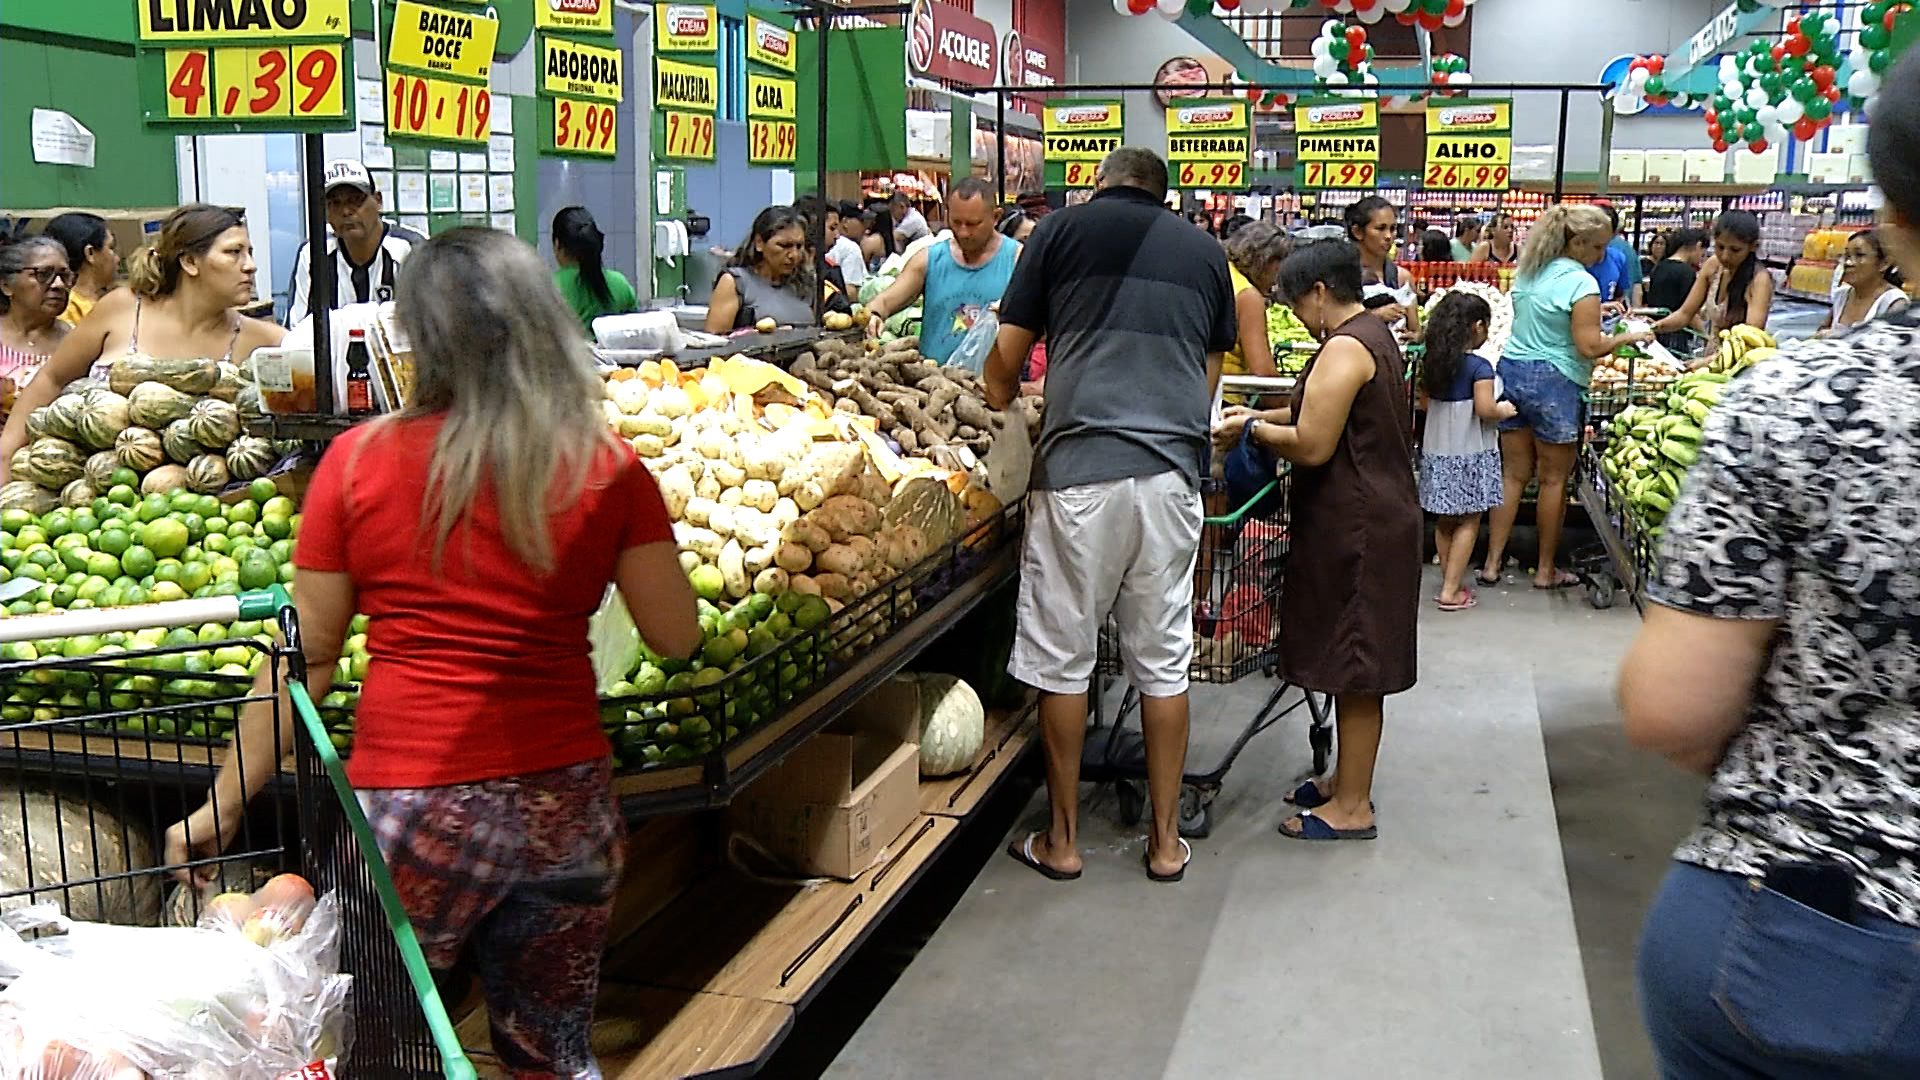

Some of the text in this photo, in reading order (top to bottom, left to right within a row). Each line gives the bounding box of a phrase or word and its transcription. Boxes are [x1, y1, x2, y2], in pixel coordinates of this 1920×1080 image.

[418, 11, 472, 40] BATATA
[422, 35, 462, 59] DOCE
[938, 27, 991, 69] AÇOUGUE
[168, 49, 337, 115] 4,39
[660, 72, 710, 104] MACAXEIRA
[755, 84, 783, 109] CARA
[556, 101, 614, 149] 3,99
[668, 114, 713, 156] 7,79
[752, 123, 795, 159] 13,99
[1170, 139, 1244, 152] BETERRABA
[1300, 139, 1376, 152] PIMENTA
[1435, 143, 1496, 158] ALHO
[1181, 162, 1241, 185] 6,99
[1307, 164, 1374, 186] 7,99
[1425, 165, 1508, 187] 26,99
